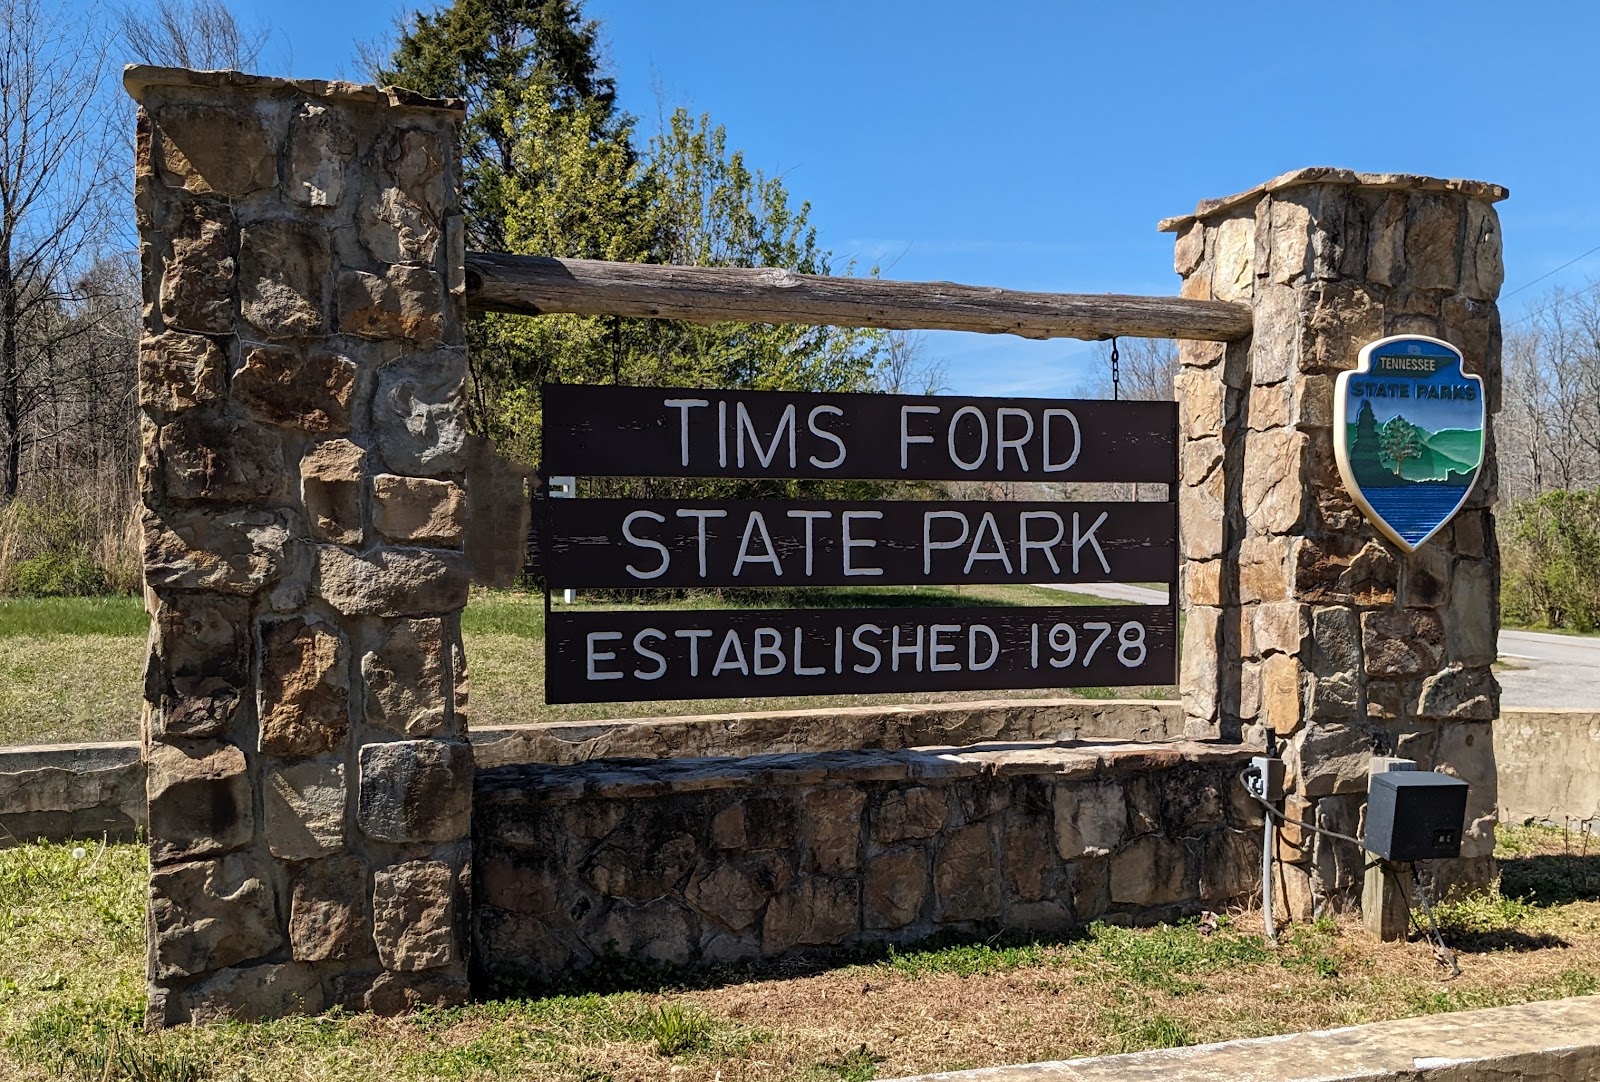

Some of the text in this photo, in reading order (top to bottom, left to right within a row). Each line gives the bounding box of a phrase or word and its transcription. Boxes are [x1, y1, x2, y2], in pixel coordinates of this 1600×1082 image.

[1351, 381, 1477, 401] STATE PARKS
[1380, 357, 1436, 371] TENNESSEE
[664, 399, 1082, 472] TIMS FORD
[622, 509, 1111, 579] STATE PARK
[586, 621, 1148, 682] ESTABLISHED 1978
